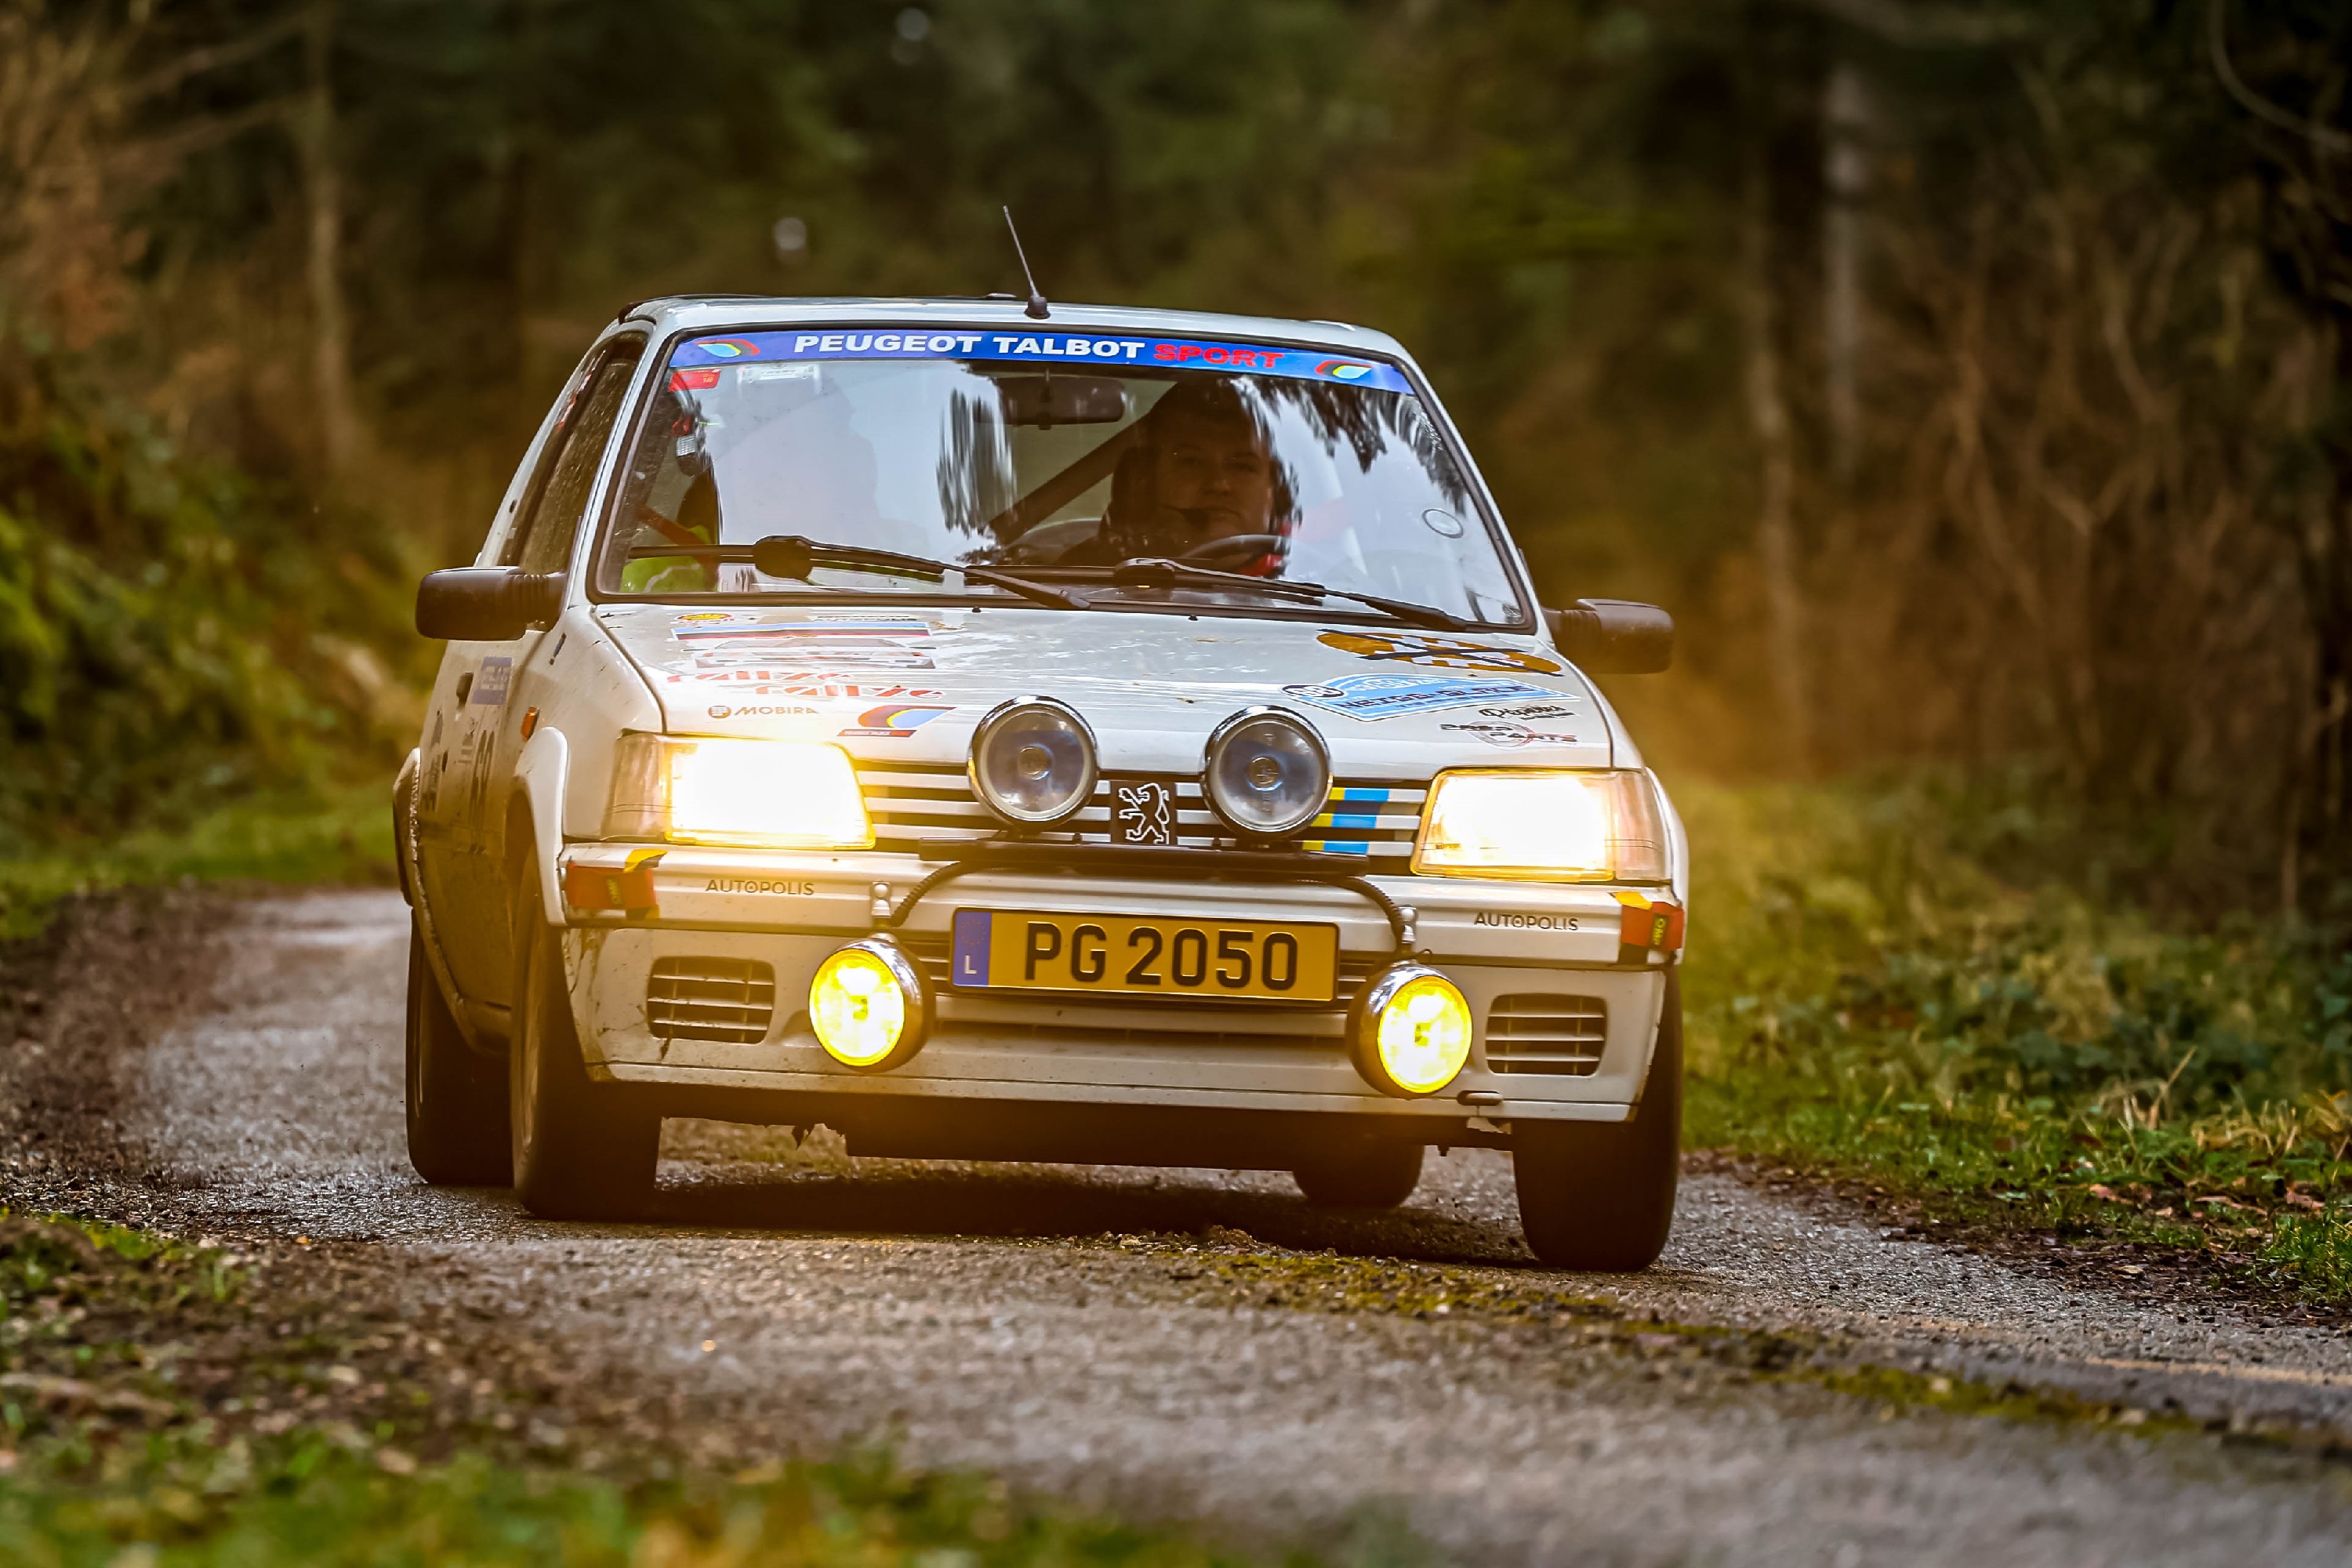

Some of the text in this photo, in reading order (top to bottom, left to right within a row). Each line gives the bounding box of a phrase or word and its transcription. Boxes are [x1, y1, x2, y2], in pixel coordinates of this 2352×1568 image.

[793, 334, 1284, 368] PEUGEOT TALBOT SPORT
[756, 685, 944, 699] rallye
[734, 706, 820, 716] MOBIRA
[706, 879, 814, 895] AUTOPOLIS
[1474, 912, 1579, 931] AUTOPOLIS
[964, 920, 1298, 990] L PG 2050
